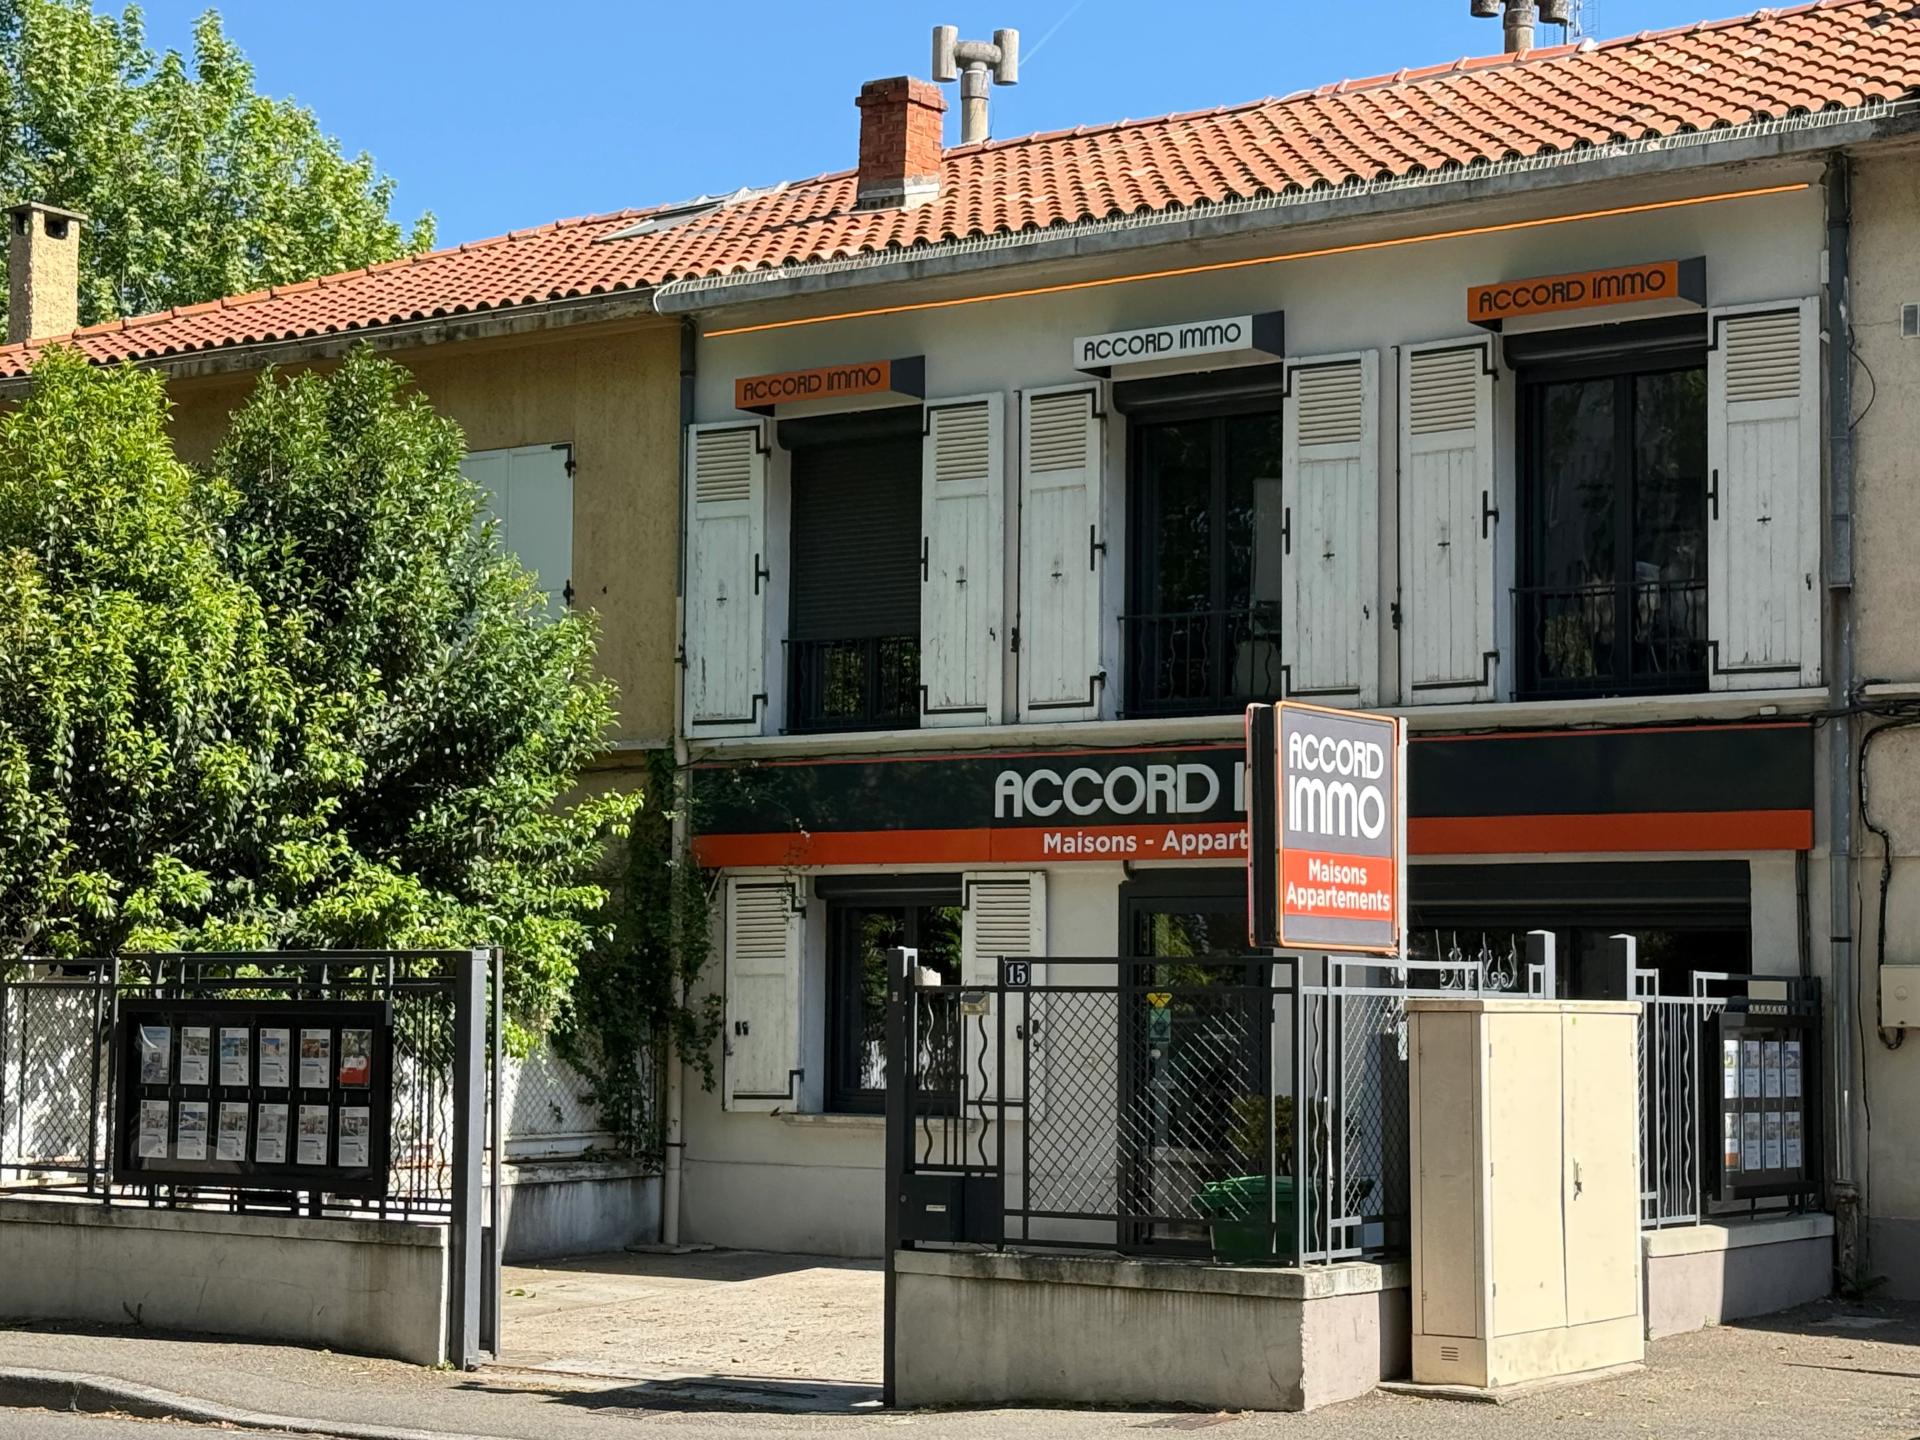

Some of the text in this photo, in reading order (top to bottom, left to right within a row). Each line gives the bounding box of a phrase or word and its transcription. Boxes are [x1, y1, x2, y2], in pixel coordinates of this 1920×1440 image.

[1480, 270, 1666, 313] ACCORD IMMO
[1084, 323, 1242, 362] ACCORD IMMO
[743, 366, 881, 401] ACCORD IMMO
[1289, 731, 1384, 780] ACCORD
[994, 763, 1220, 818] ACCORD
[1289, 774, 1385, 840] IMMO
[1043, 832, 1137, 854] Maisons
[1162, 830, 1248, 855] Appart
[1308, 858, 1368, 886] Maisons
[1286, 882, 1390, 912] Appartements
[1008, 964, 1026, 984] 15
